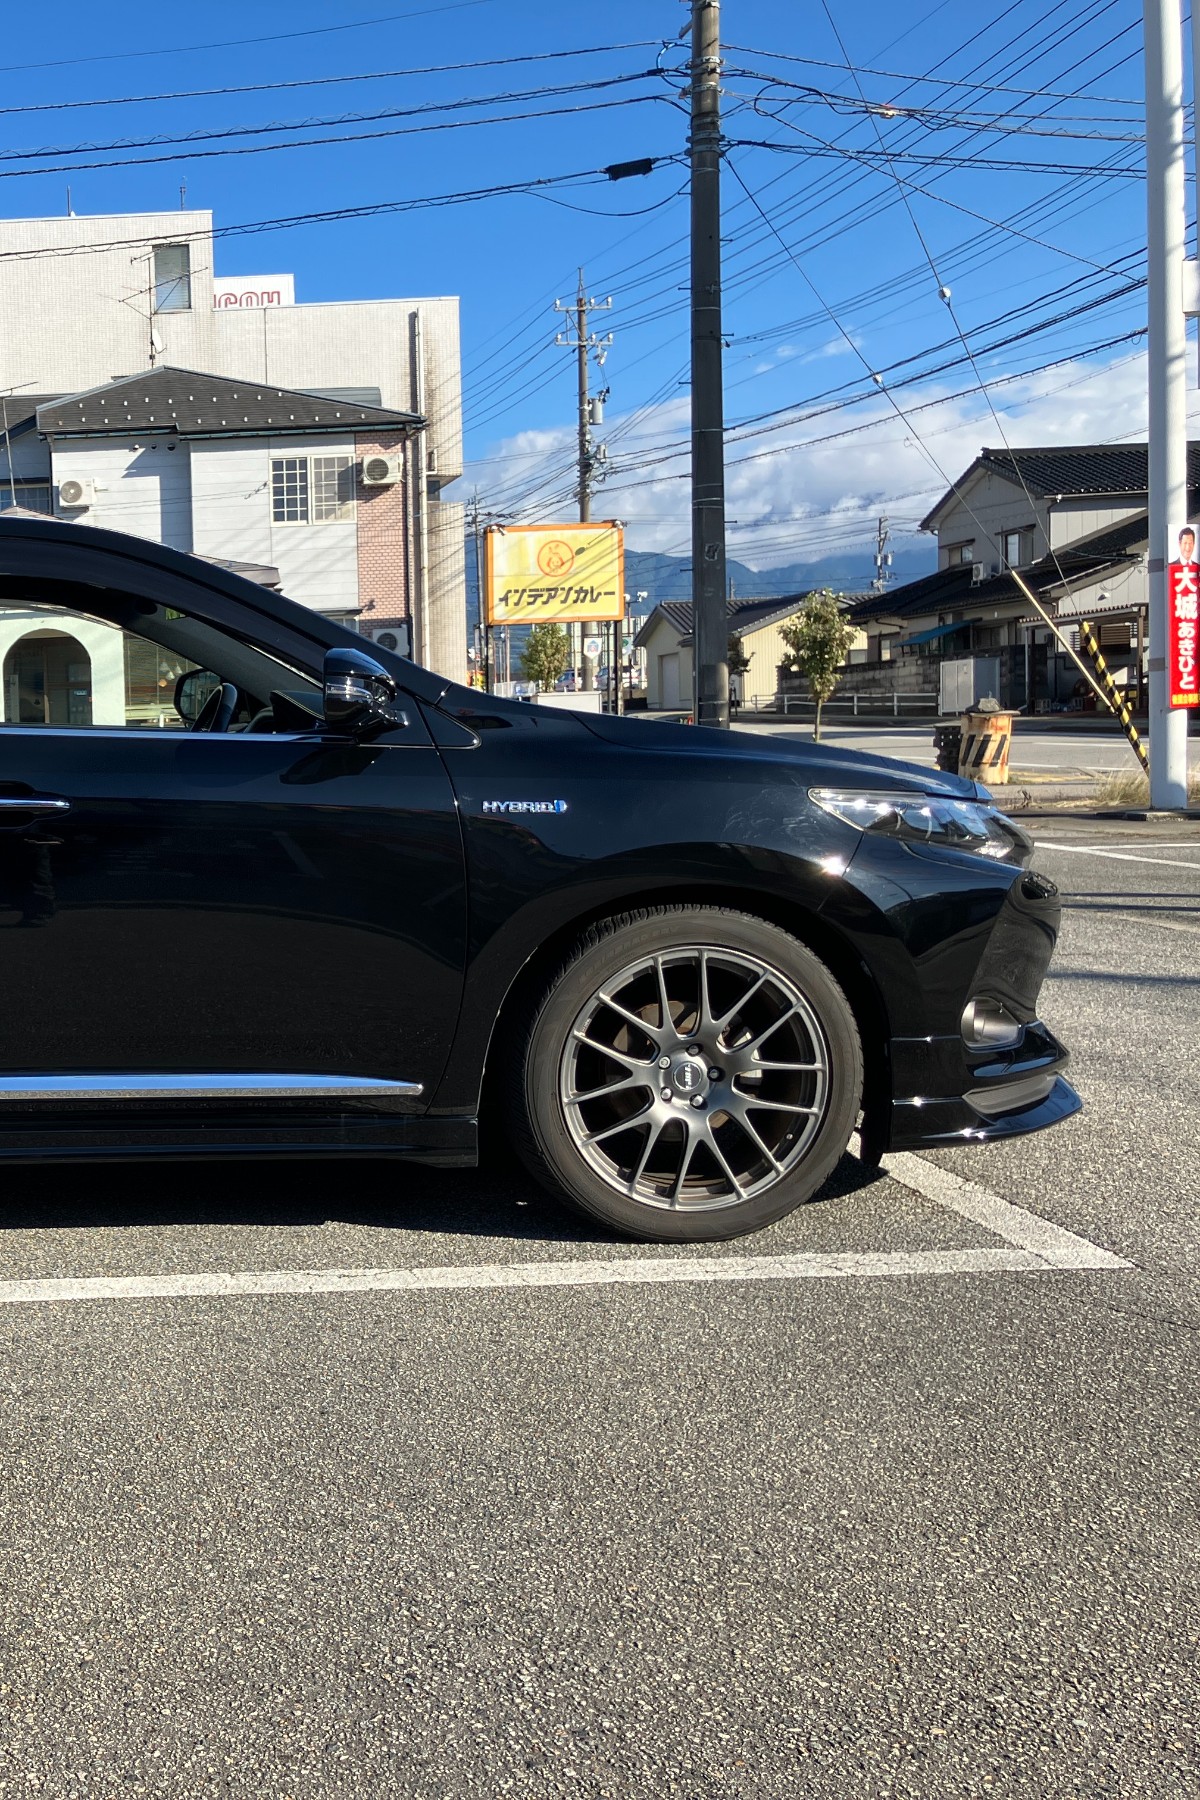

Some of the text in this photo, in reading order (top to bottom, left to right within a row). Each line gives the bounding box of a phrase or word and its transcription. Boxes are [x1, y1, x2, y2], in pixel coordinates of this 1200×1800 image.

[498, 586, 616, 607] インデアンカレー
[482, 800, 556, 813] HYBRID
